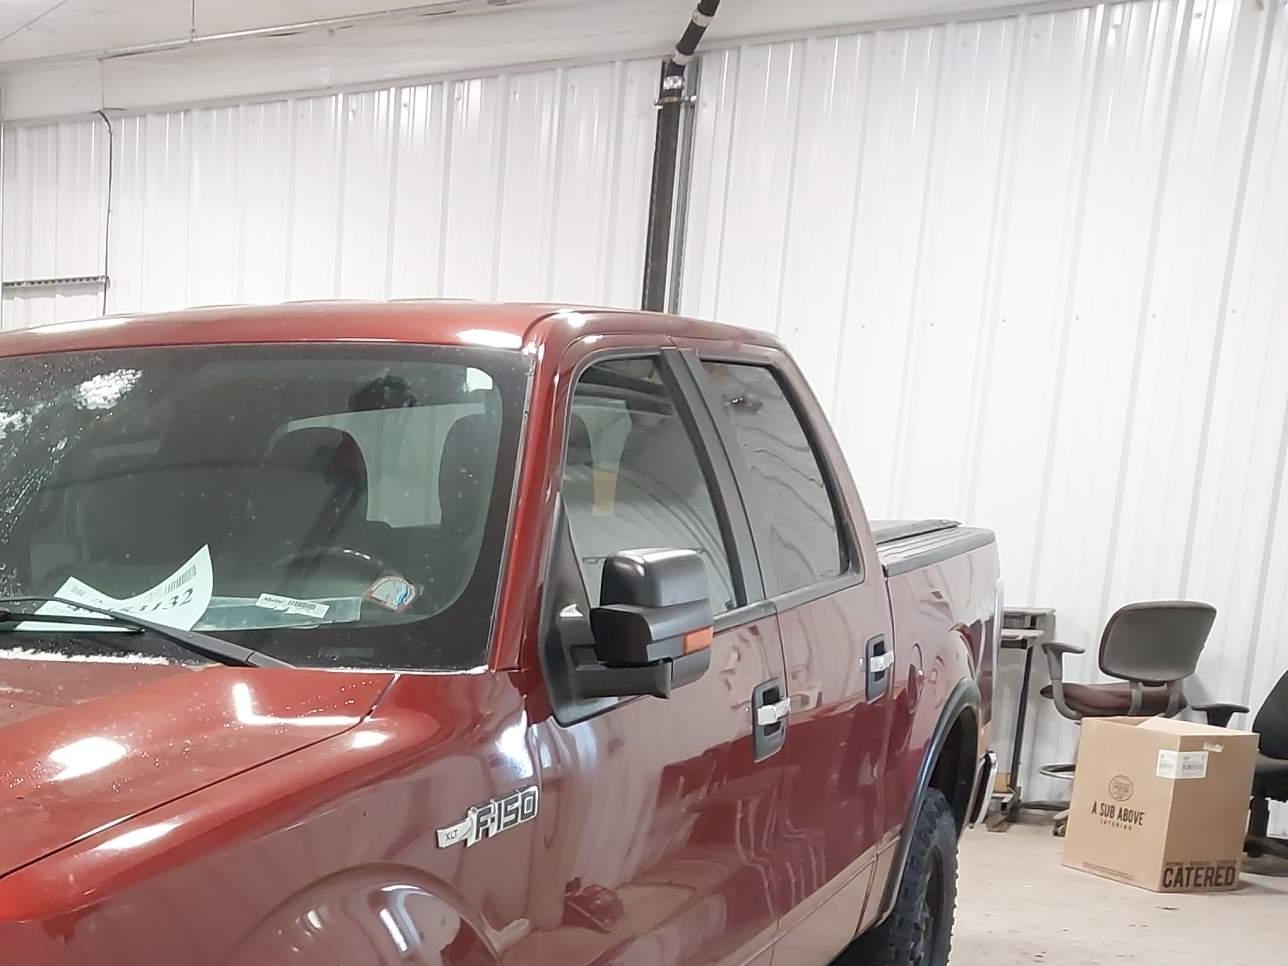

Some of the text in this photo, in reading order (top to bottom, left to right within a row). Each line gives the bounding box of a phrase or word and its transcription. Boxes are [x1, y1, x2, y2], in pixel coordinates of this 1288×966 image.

[1092, 801, 1145, 826] A SUB ABOVE
[444, 829, 459, 842] XLT
[1162, 866, 1236, 889] CATERED
